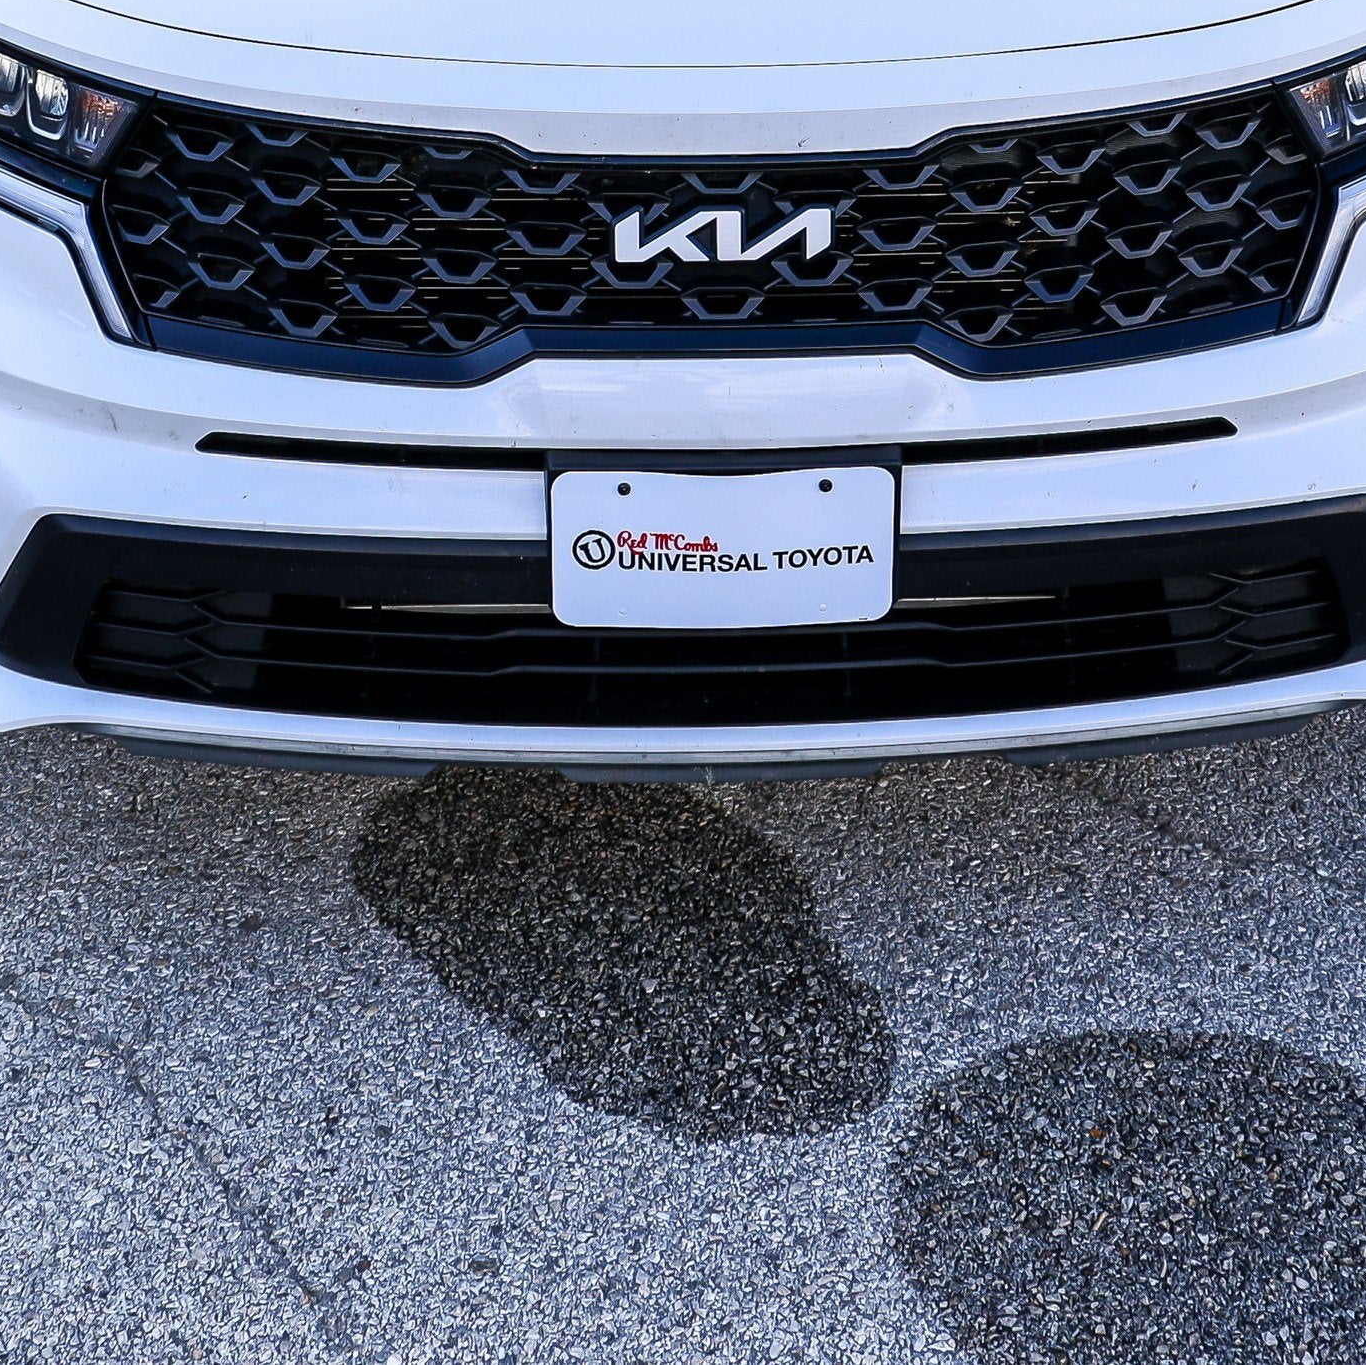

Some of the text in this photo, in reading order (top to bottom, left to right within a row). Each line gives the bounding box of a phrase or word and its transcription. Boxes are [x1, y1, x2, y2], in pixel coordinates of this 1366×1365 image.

[616, 530, 719, 555] Red McCombs
[618, 545, 875, 573] UNIVERSAL TOYOTA
